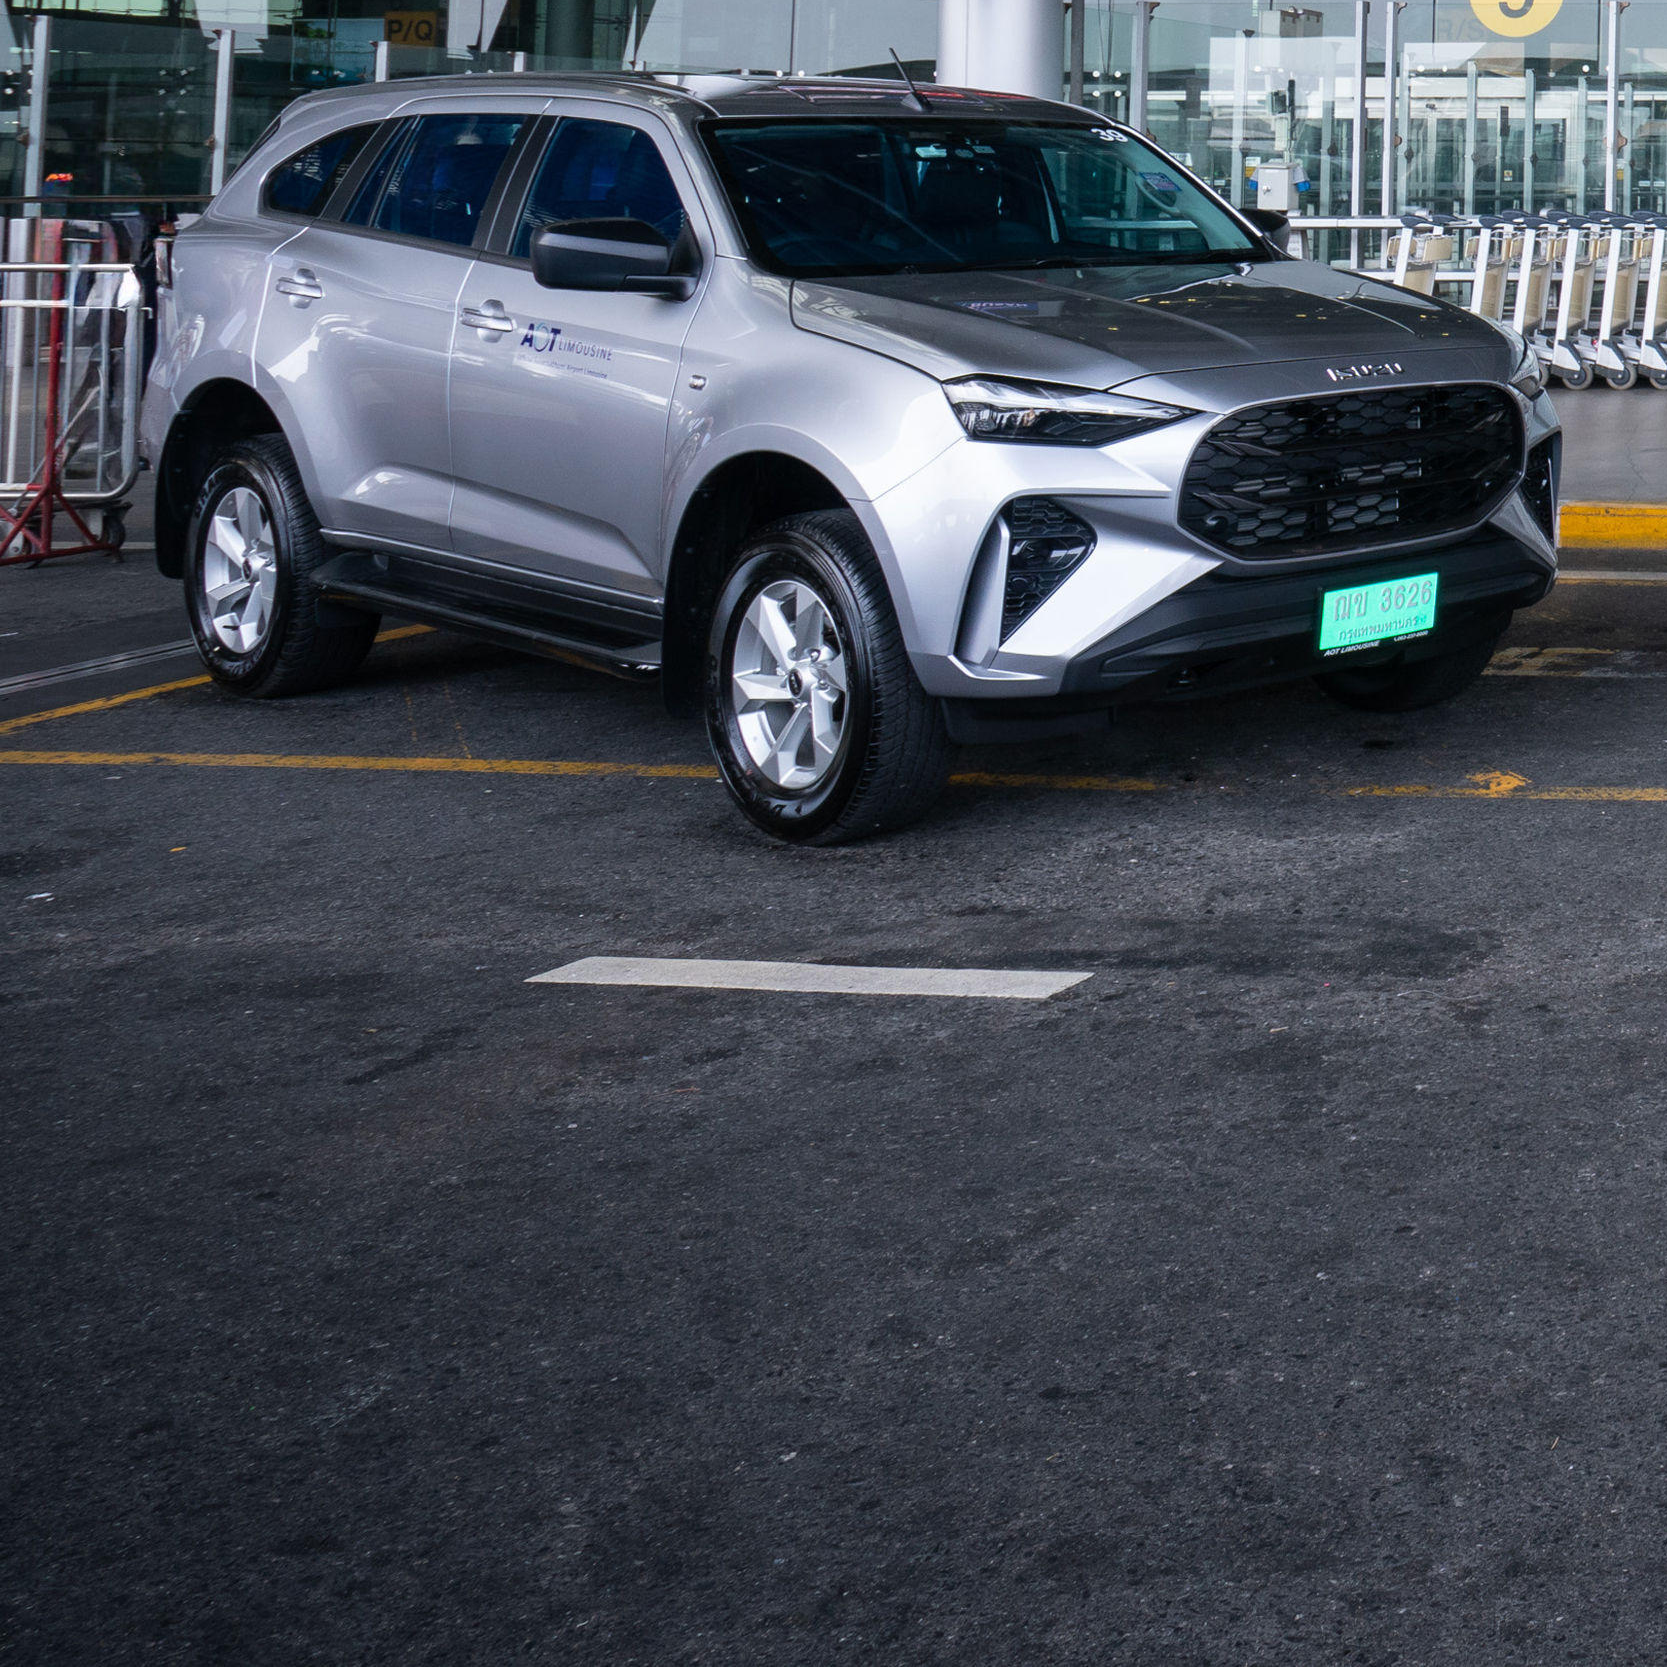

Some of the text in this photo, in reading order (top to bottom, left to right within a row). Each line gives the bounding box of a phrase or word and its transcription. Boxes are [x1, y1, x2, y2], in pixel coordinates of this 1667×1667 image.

[387, 19, 434, 42] P/Q
[1090, 128, 1128, 143] 39
[521, 321, 562, 352] AOT
[558, 337, 613, 361] LIMOUSINE
[1327, 363, 1405, 382] ISUZU
[1379, 580, 1433, 613] 3626
[1339, 616, 1419, 643] กรุงเทพมหานคร
[1324, 647, 1341, 657] AOT
[1341, 640, 1380, 653] LIMOUSINE
